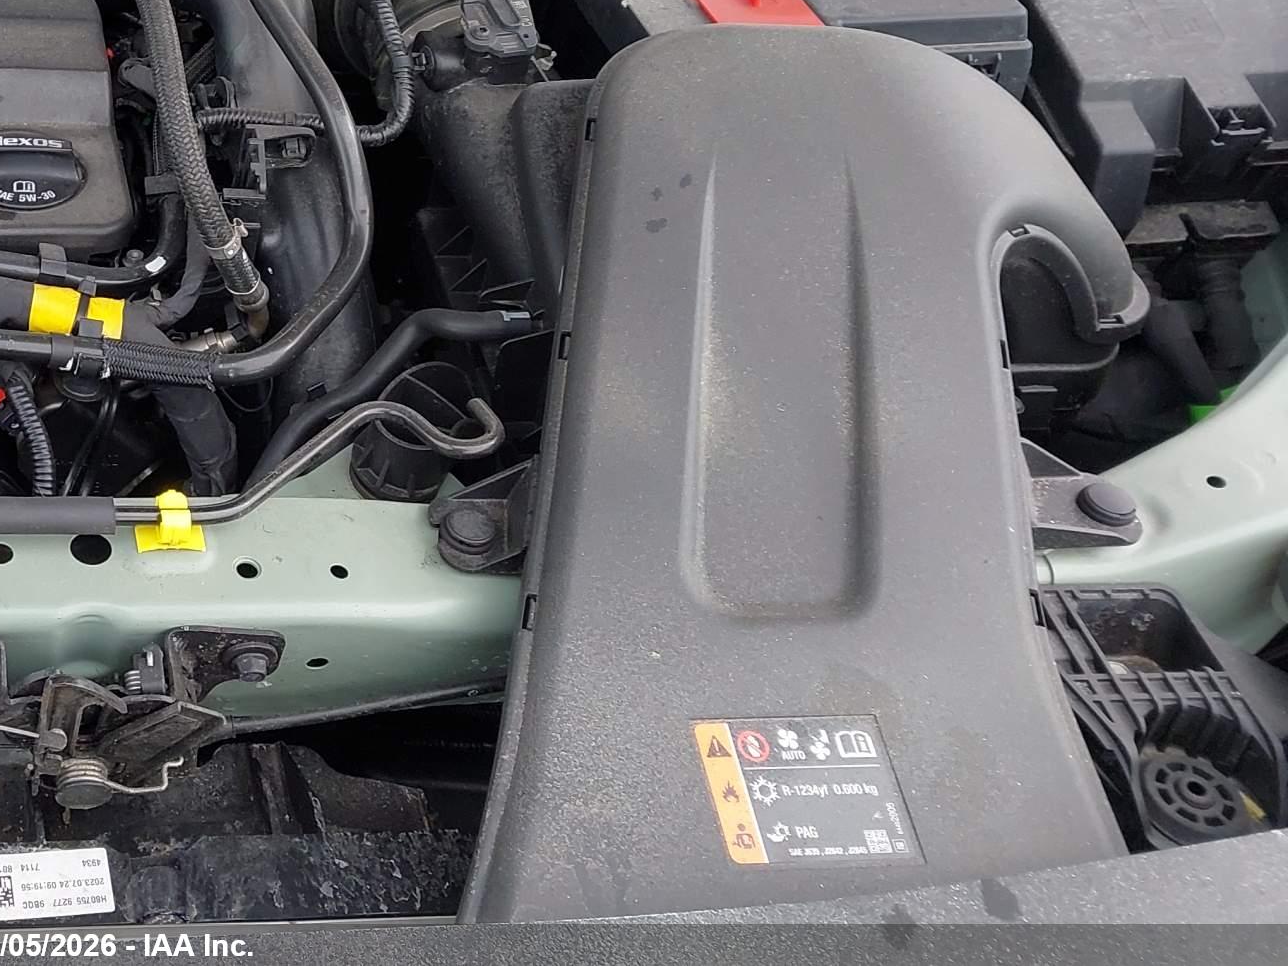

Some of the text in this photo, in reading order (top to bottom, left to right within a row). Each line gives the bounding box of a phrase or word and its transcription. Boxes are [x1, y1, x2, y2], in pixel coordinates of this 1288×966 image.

[19, 190, 56, 202] 5W-30
[781, 750, 806, 760] AUTO
[782, 785, 829, 798] R-1234yf
[863, 783, 879, 796] kg
[795, 825, 819, 839] PAG
[20, 863, 40, 872] 7114
[82, 859, 101, 867] 4934
[59, 877, 105, 888] 2023.07.24
[53, 898, 73, 907] 9277
